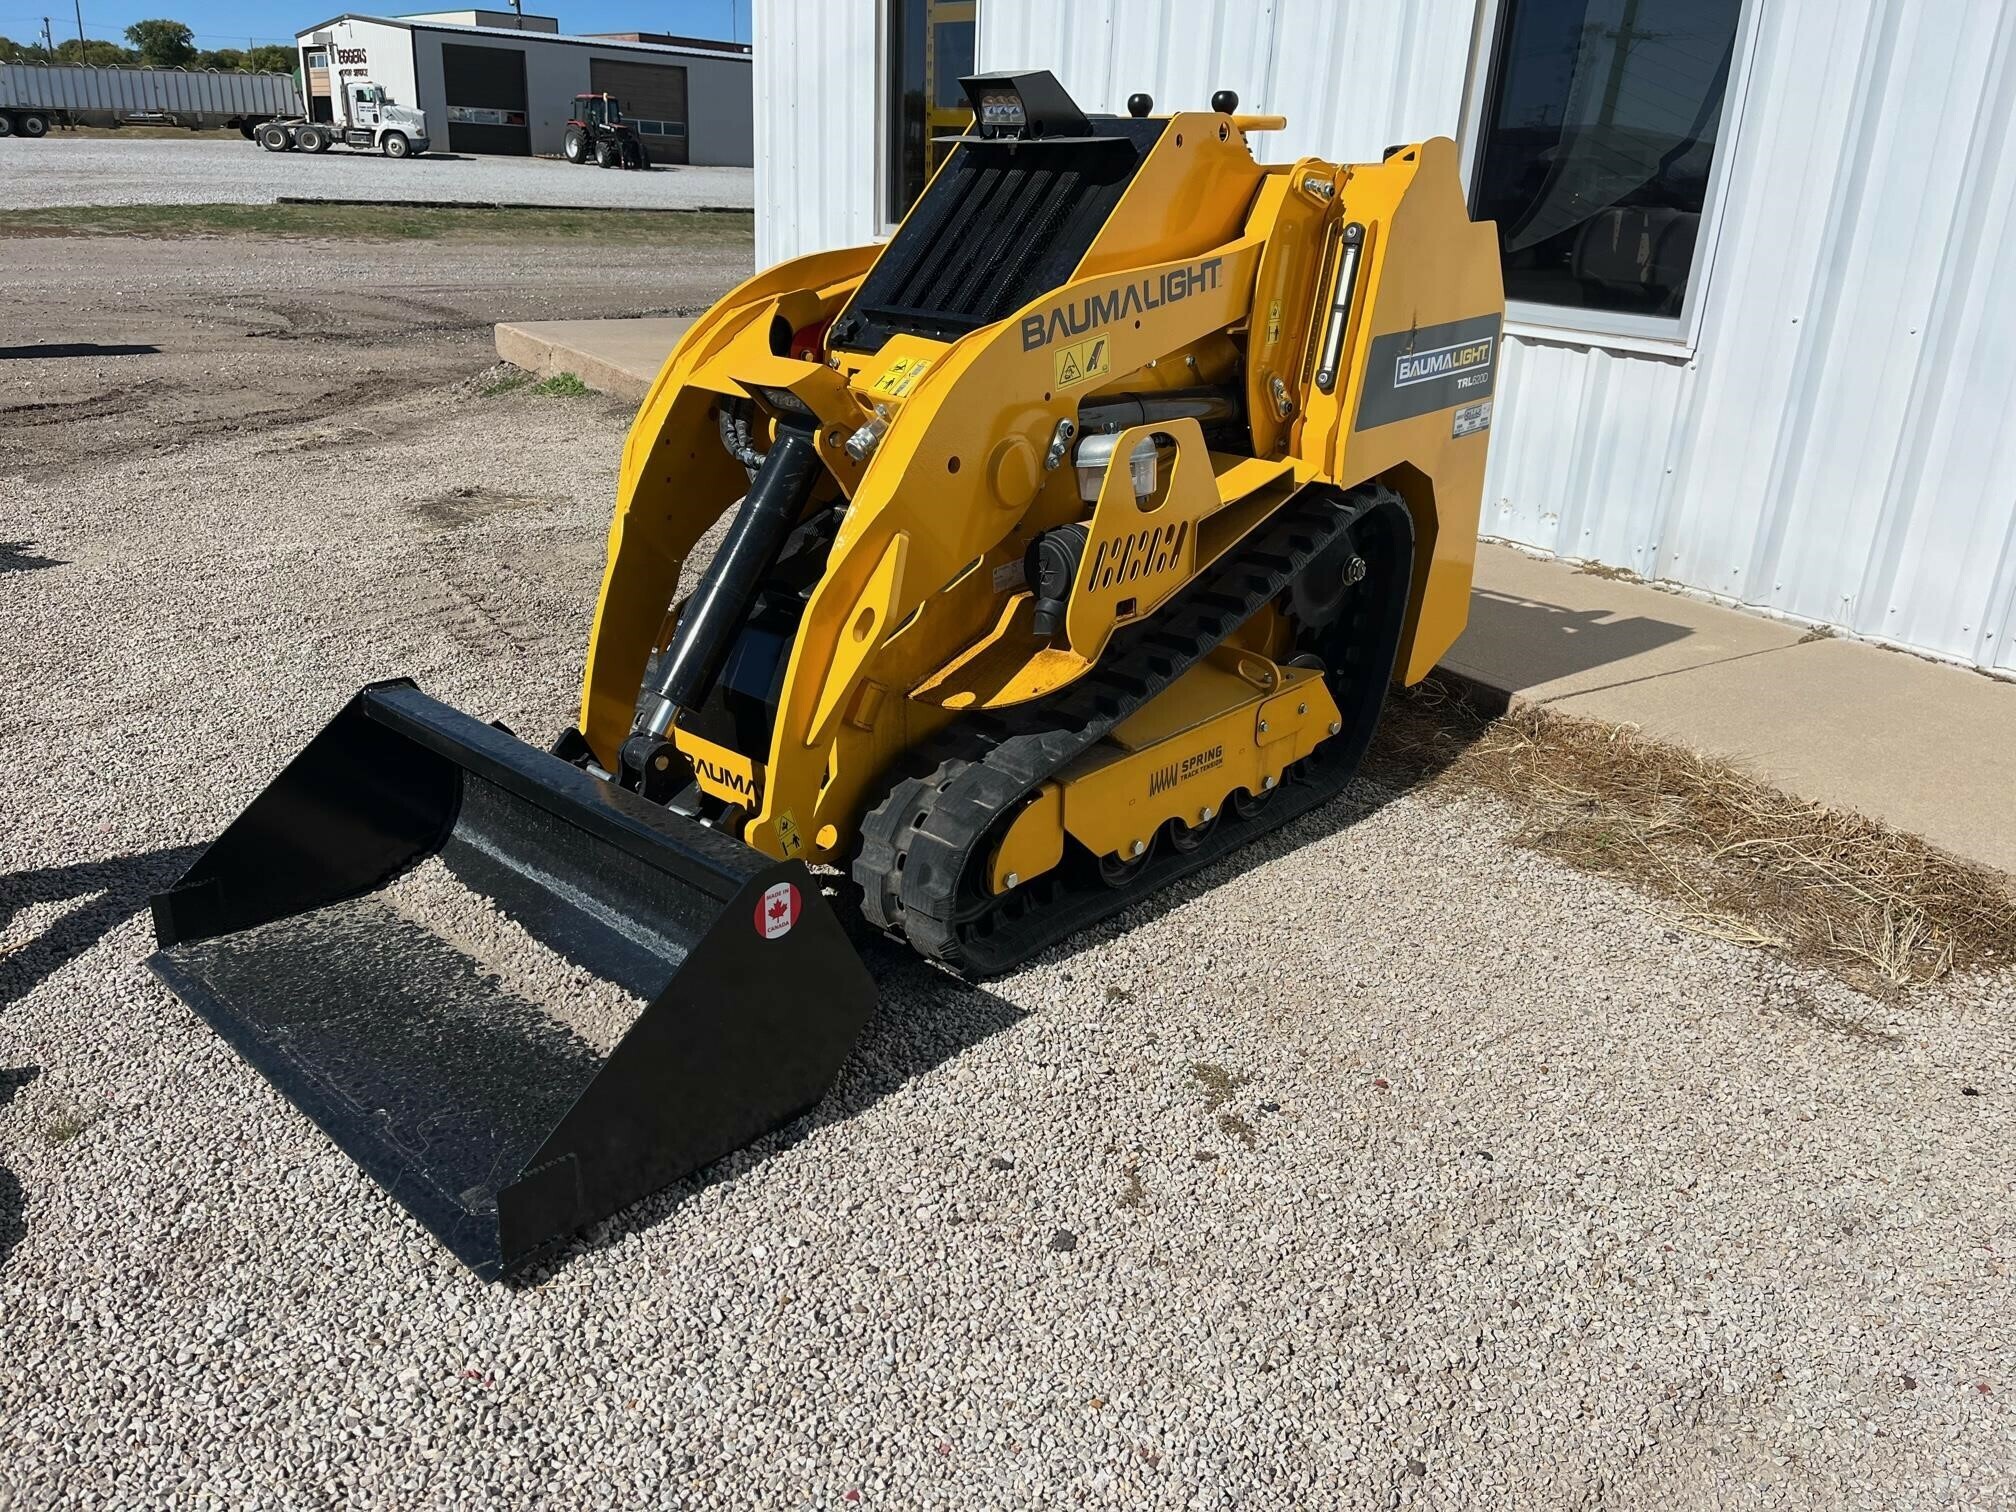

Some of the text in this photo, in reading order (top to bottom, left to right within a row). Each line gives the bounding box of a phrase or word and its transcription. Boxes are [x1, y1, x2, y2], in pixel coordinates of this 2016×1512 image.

[338, 48, 367, 64] EGGERS
[1021, 257, 1223, 352] BAUMALIGHT
[1399, 344, 1489, 380] BAUMALIGHT
[1180, 758, 1223, 781] TRACK TENSION
[1181, 745, 1222, 773] SPRING
[766, 890, 782, 900] MADE
[767, 920, 789, 933] CANADA
